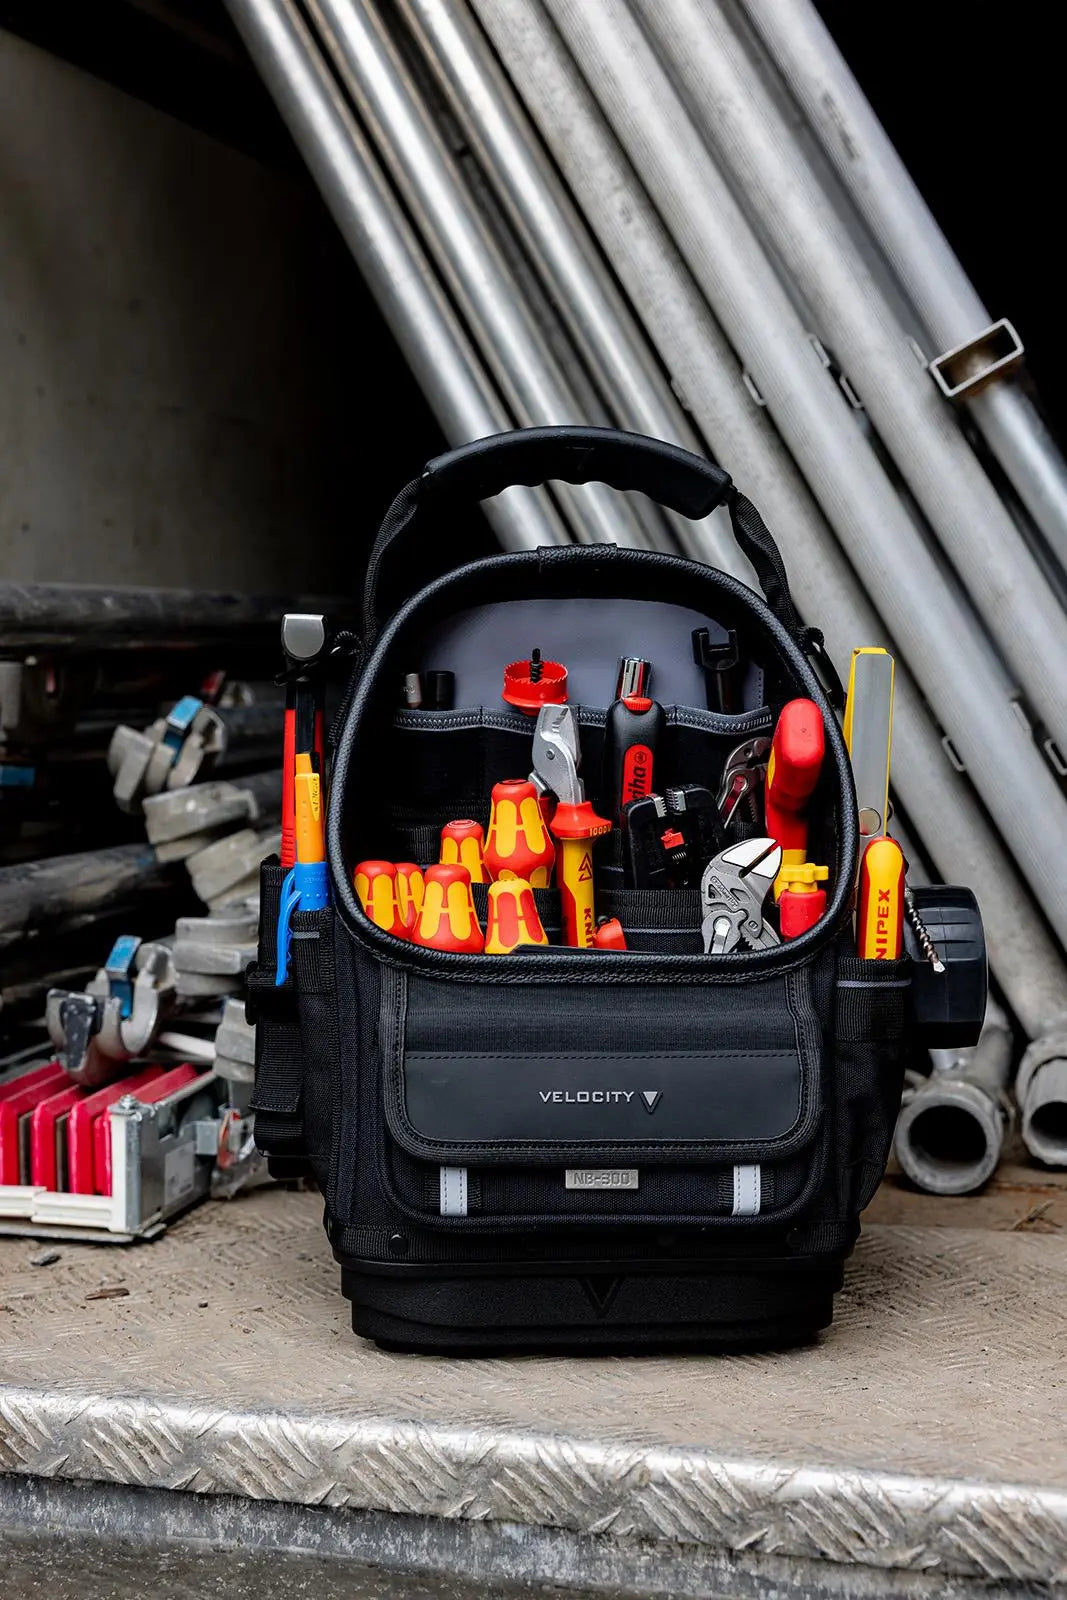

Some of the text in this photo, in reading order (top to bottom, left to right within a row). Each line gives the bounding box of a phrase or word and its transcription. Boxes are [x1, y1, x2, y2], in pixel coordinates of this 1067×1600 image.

[628, 766, 647, 799] iha
[875, 889, 890, 960] NIPEX
[539, 1091, 635, 1103] VELOCITY
[573, 1172, 630, 1186] NB-300
